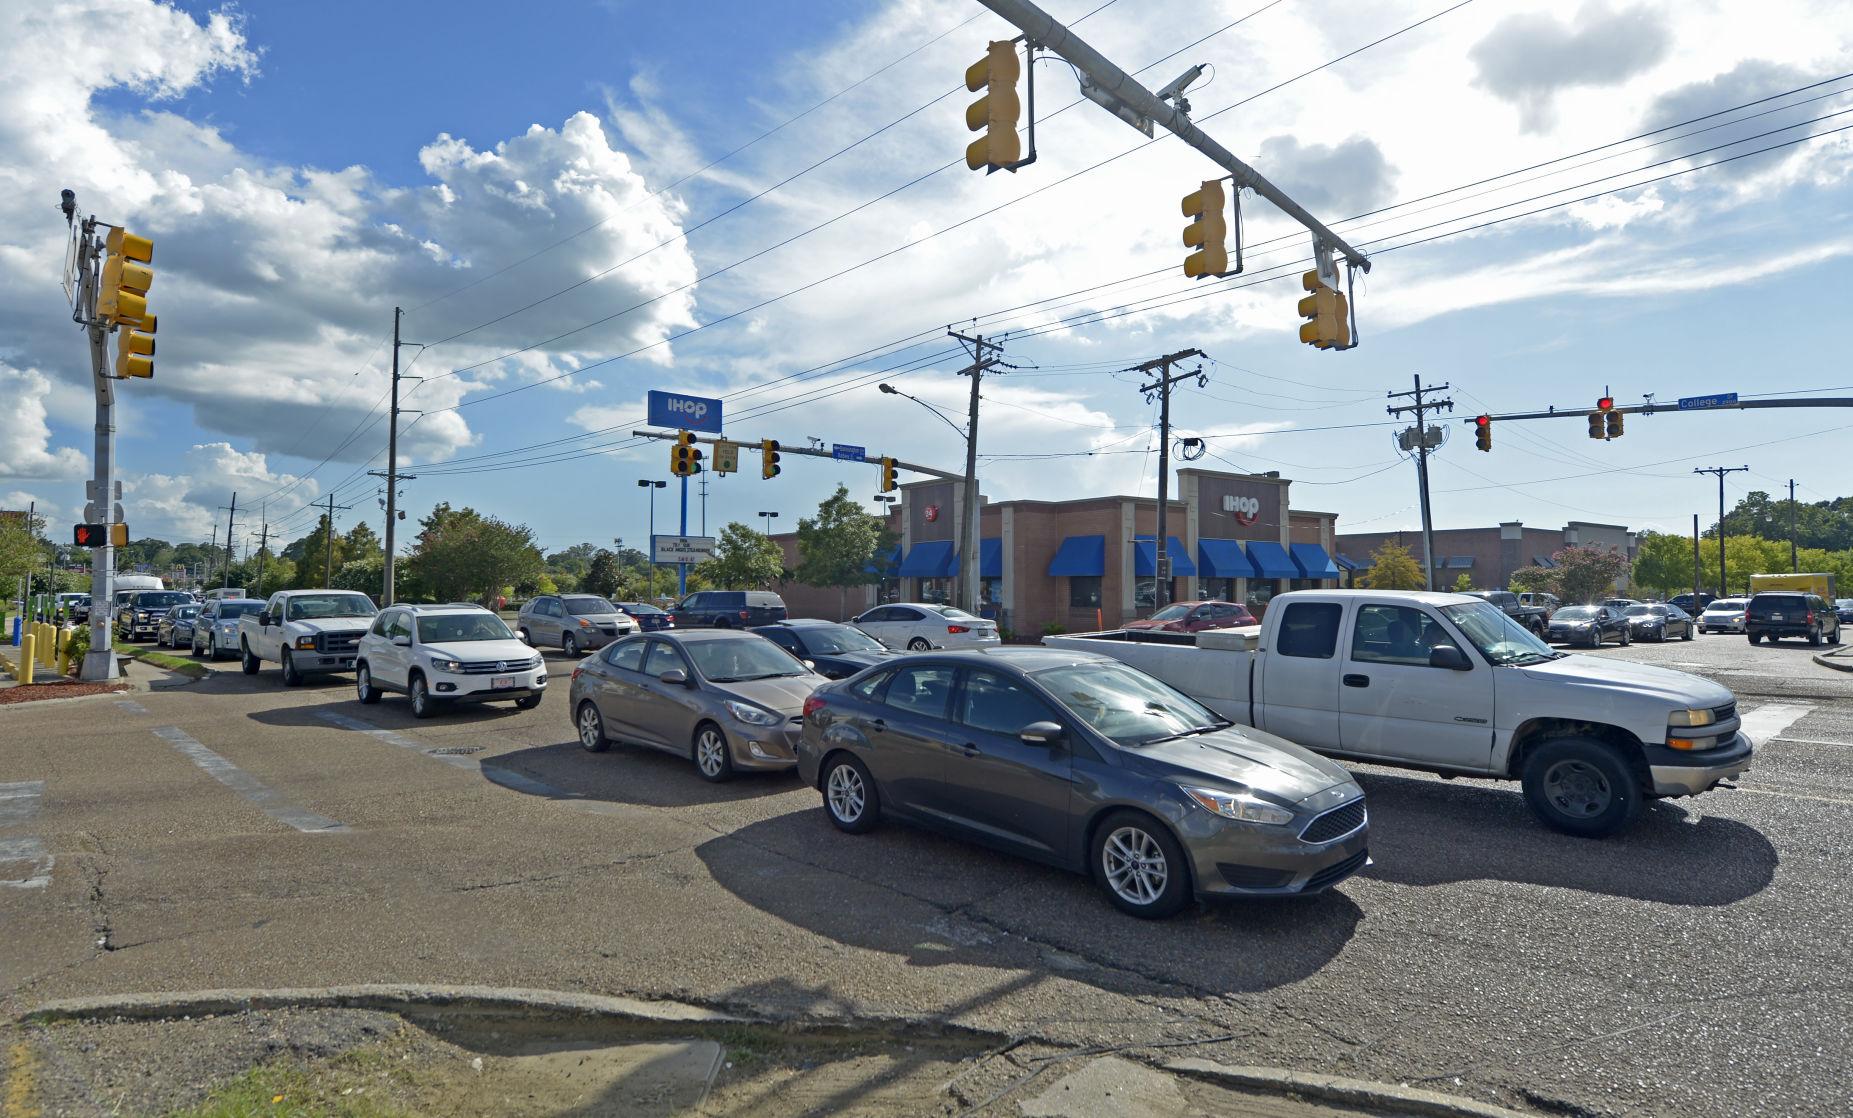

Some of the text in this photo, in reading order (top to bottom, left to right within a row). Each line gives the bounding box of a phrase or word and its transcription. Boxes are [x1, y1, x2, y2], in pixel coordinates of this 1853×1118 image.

[667, 398, 707, 419] IHOP
[1681, 398, 1717, 408] College
[1223, 495, 1259, 519] IHOP
